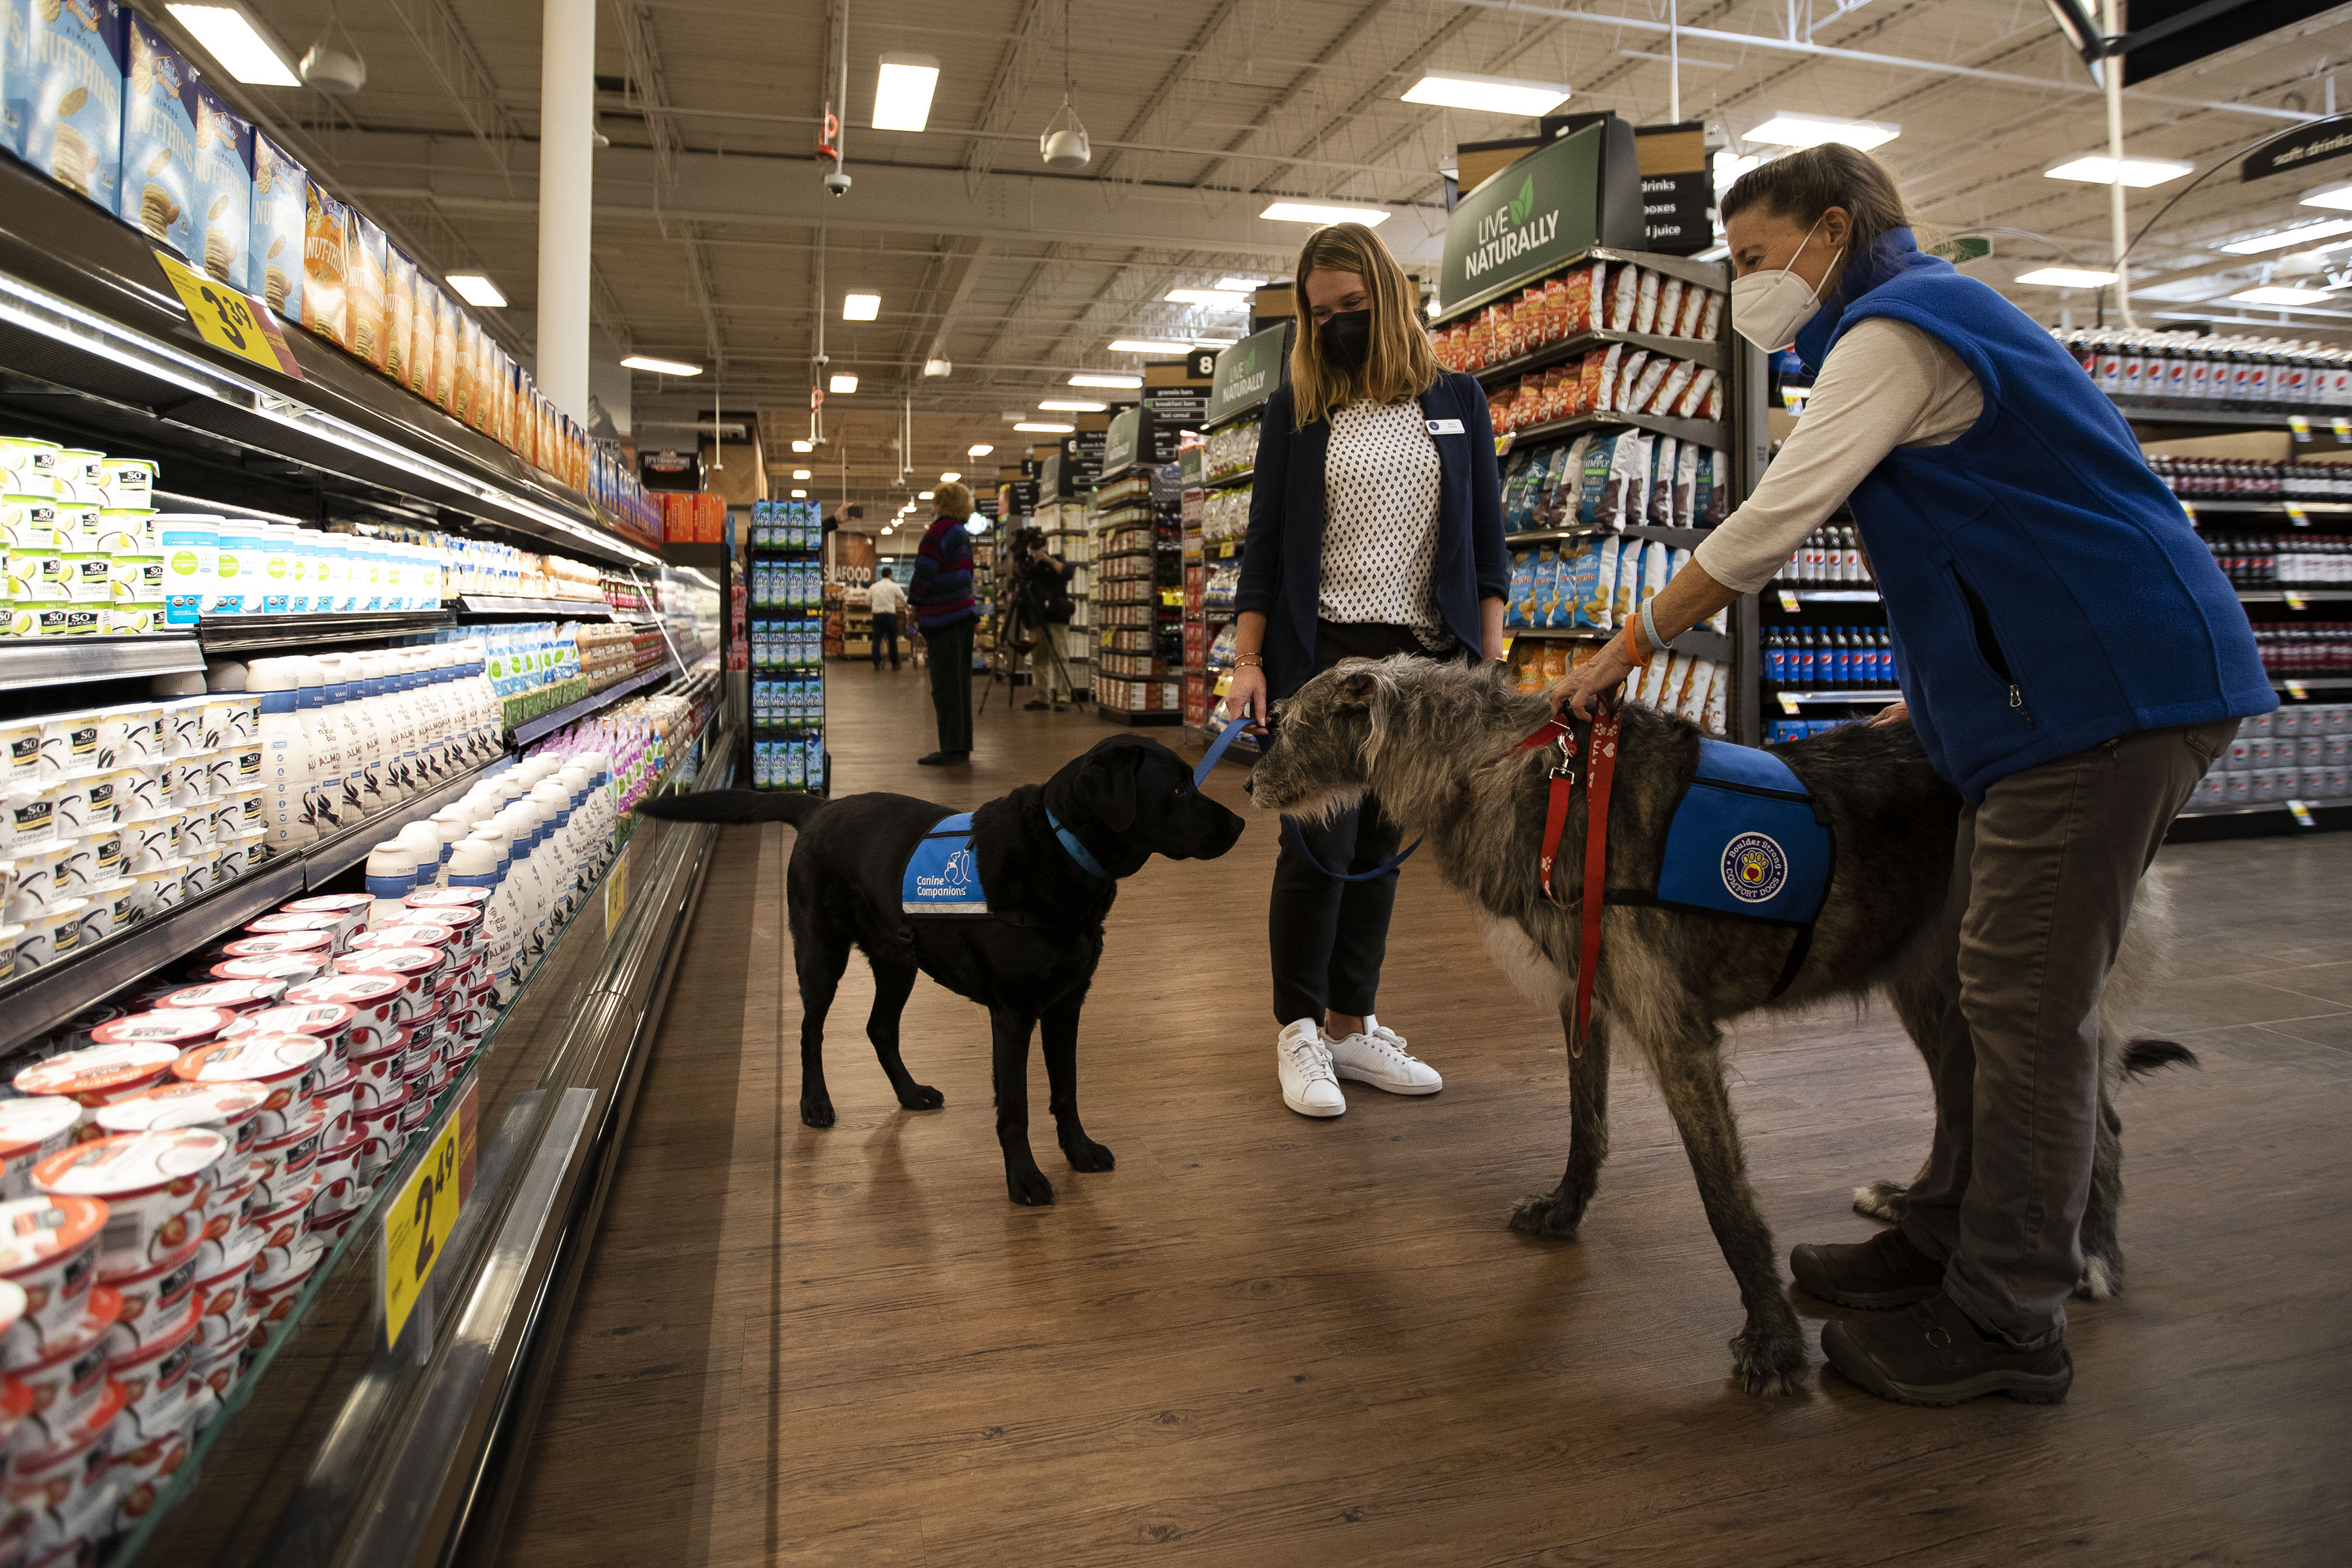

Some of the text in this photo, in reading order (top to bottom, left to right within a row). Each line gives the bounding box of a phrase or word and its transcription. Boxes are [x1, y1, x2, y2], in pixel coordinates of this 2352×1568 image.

[1478, 205, 1508, 246] LIVE
[1465, 209, 1559, 281] NATURALLY
[1200, 356, 1213, 373] 8
[1228, 362, 1245, 383] LIVE
[1222, 370, 1266, 403] NATURALLY
[41, 455, 54, 463] SO
[1585, 459, 1610, 468] SIMPLY
[39, 508, 52, 517] SO
[50, 561, 59, 570] SO
[90, 563, 104, 572] SO
[824, 564, 871, 582] SAFOOD
[50, 612, 63, 621] SO
[71, 613, 90, 622] SO
[81, 729, 95, 740] SO
[22, 739, 37, 750] SO
[99, 785, 112, 796] SO
[27, 803, 46, 815] SO
[107, 841, 120, 853] SO
[254, 843, 262, 852] SO
[1729, 838, 1781, 870] Boulder Strong
[917, 875, 944, 885] Canine
[1726, 867, 1780, 898] COMFORT DOGS
[121, 897, 131, 908] SO
[65, 921, 78, 934] SO
[417, 1026, 431, 1037] SO
